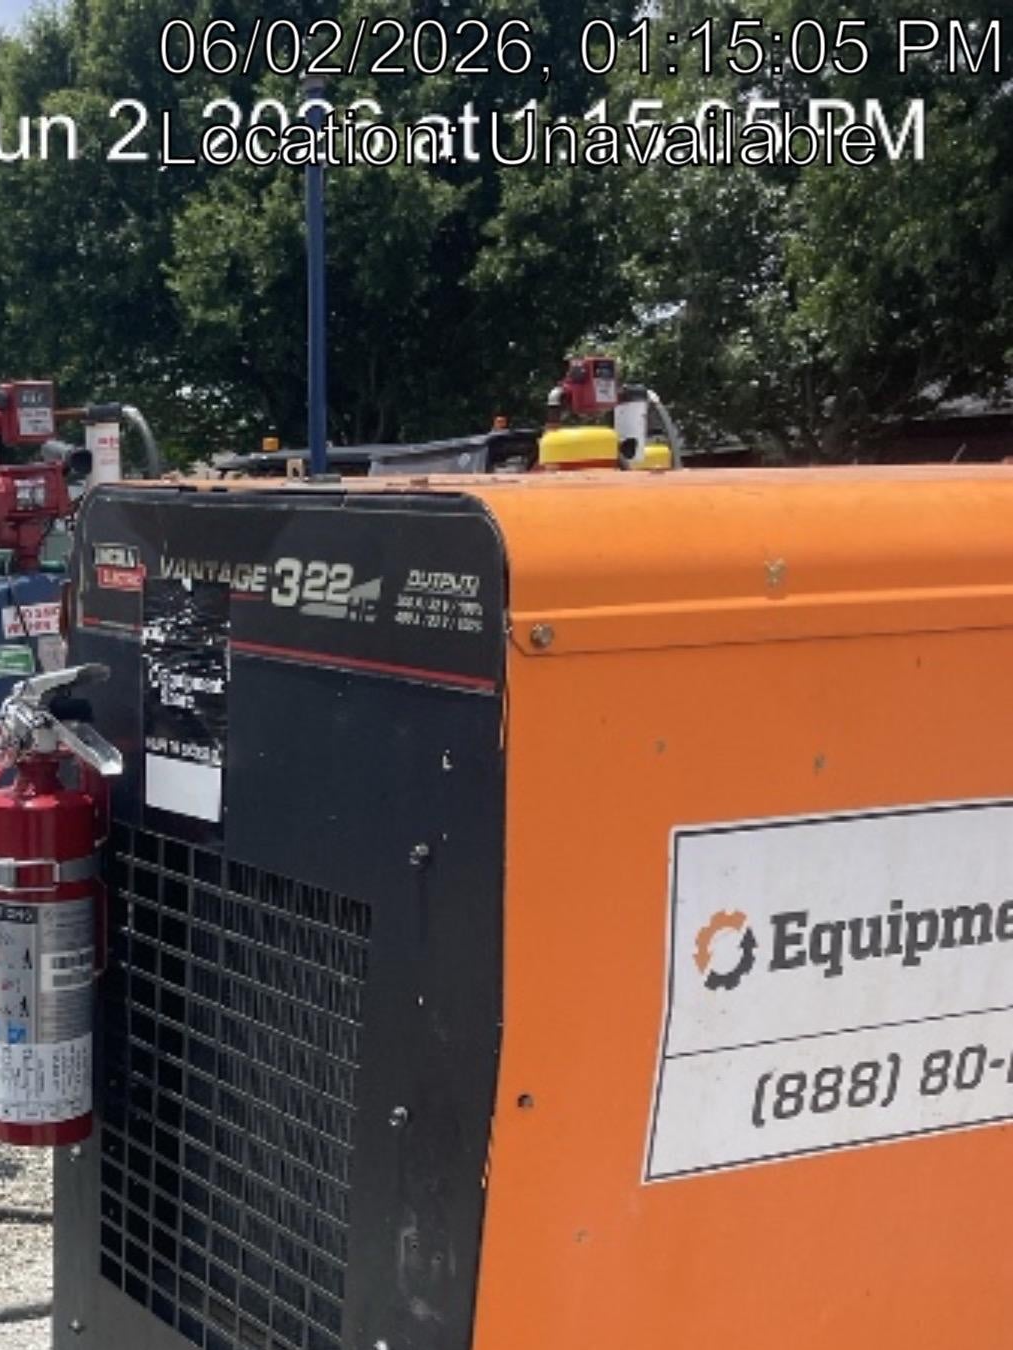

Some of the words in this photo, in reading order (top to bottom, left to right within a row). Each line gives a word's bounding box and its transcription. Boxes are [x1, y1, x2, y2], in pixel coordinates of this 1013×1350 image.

[160, 554, 268, 593] VANTAGE
[271, 556, 354, 608] 322
[752, 1052, 902, 1128] (888)
[919, 1043, 1013, 1097] 80-
